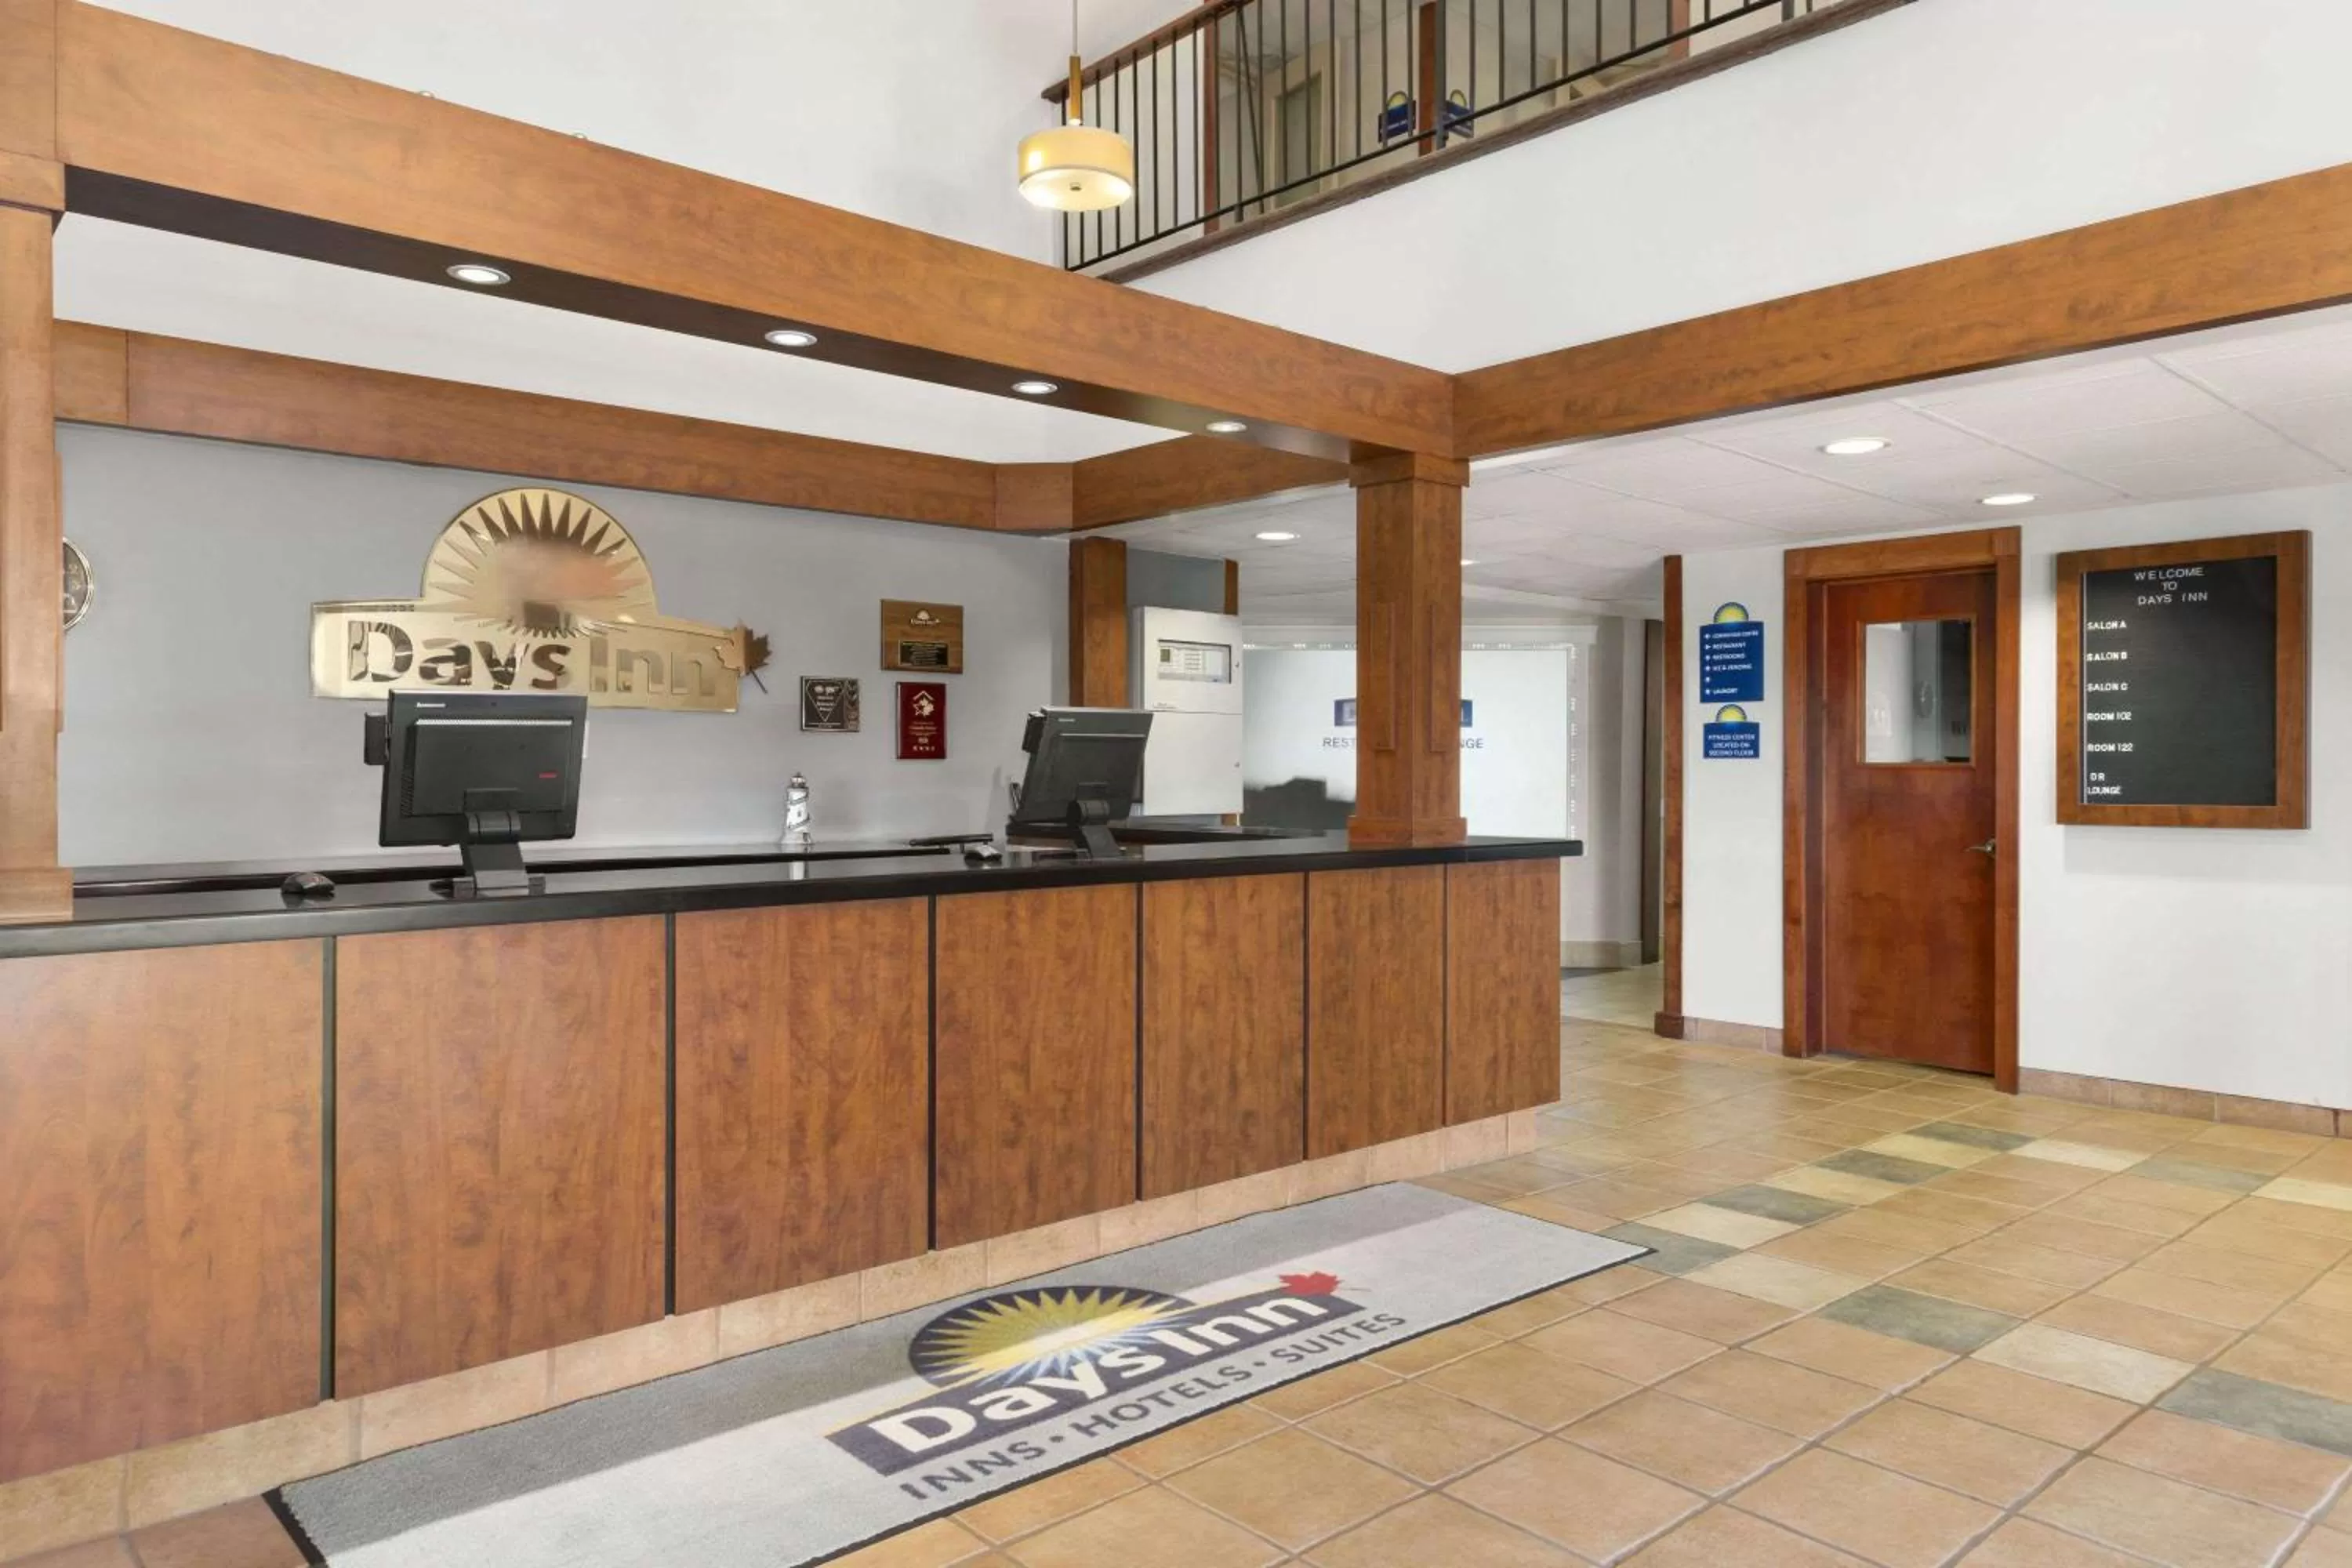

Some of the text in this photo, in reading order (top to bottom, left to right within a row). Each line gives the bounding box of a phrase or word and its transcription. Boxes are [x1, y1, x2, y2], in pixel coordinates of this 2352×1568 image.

[2133, 567, 2205, 581] WELCOME
[2161, 581, 2178, 590] TO
[2138, 591, 2208, 605] DAYS INN
[2087, 619, 2127, 630] SALON A
[347, 621, 572, 691] Days
[2086, 652, 2119, 662] SALON
[2087, 683, 2119, 692] SALON
[2086, 711, 2132, 720] ROOM 102
[2087, 742, 2133, 752] ROOM 122
[2086, 786, 2122, 795] LOUNGE
[867, 1297, 1329, 1454] Days Inn
[899, 1312, 1407, 1501] INNS HOTELS SUITES
